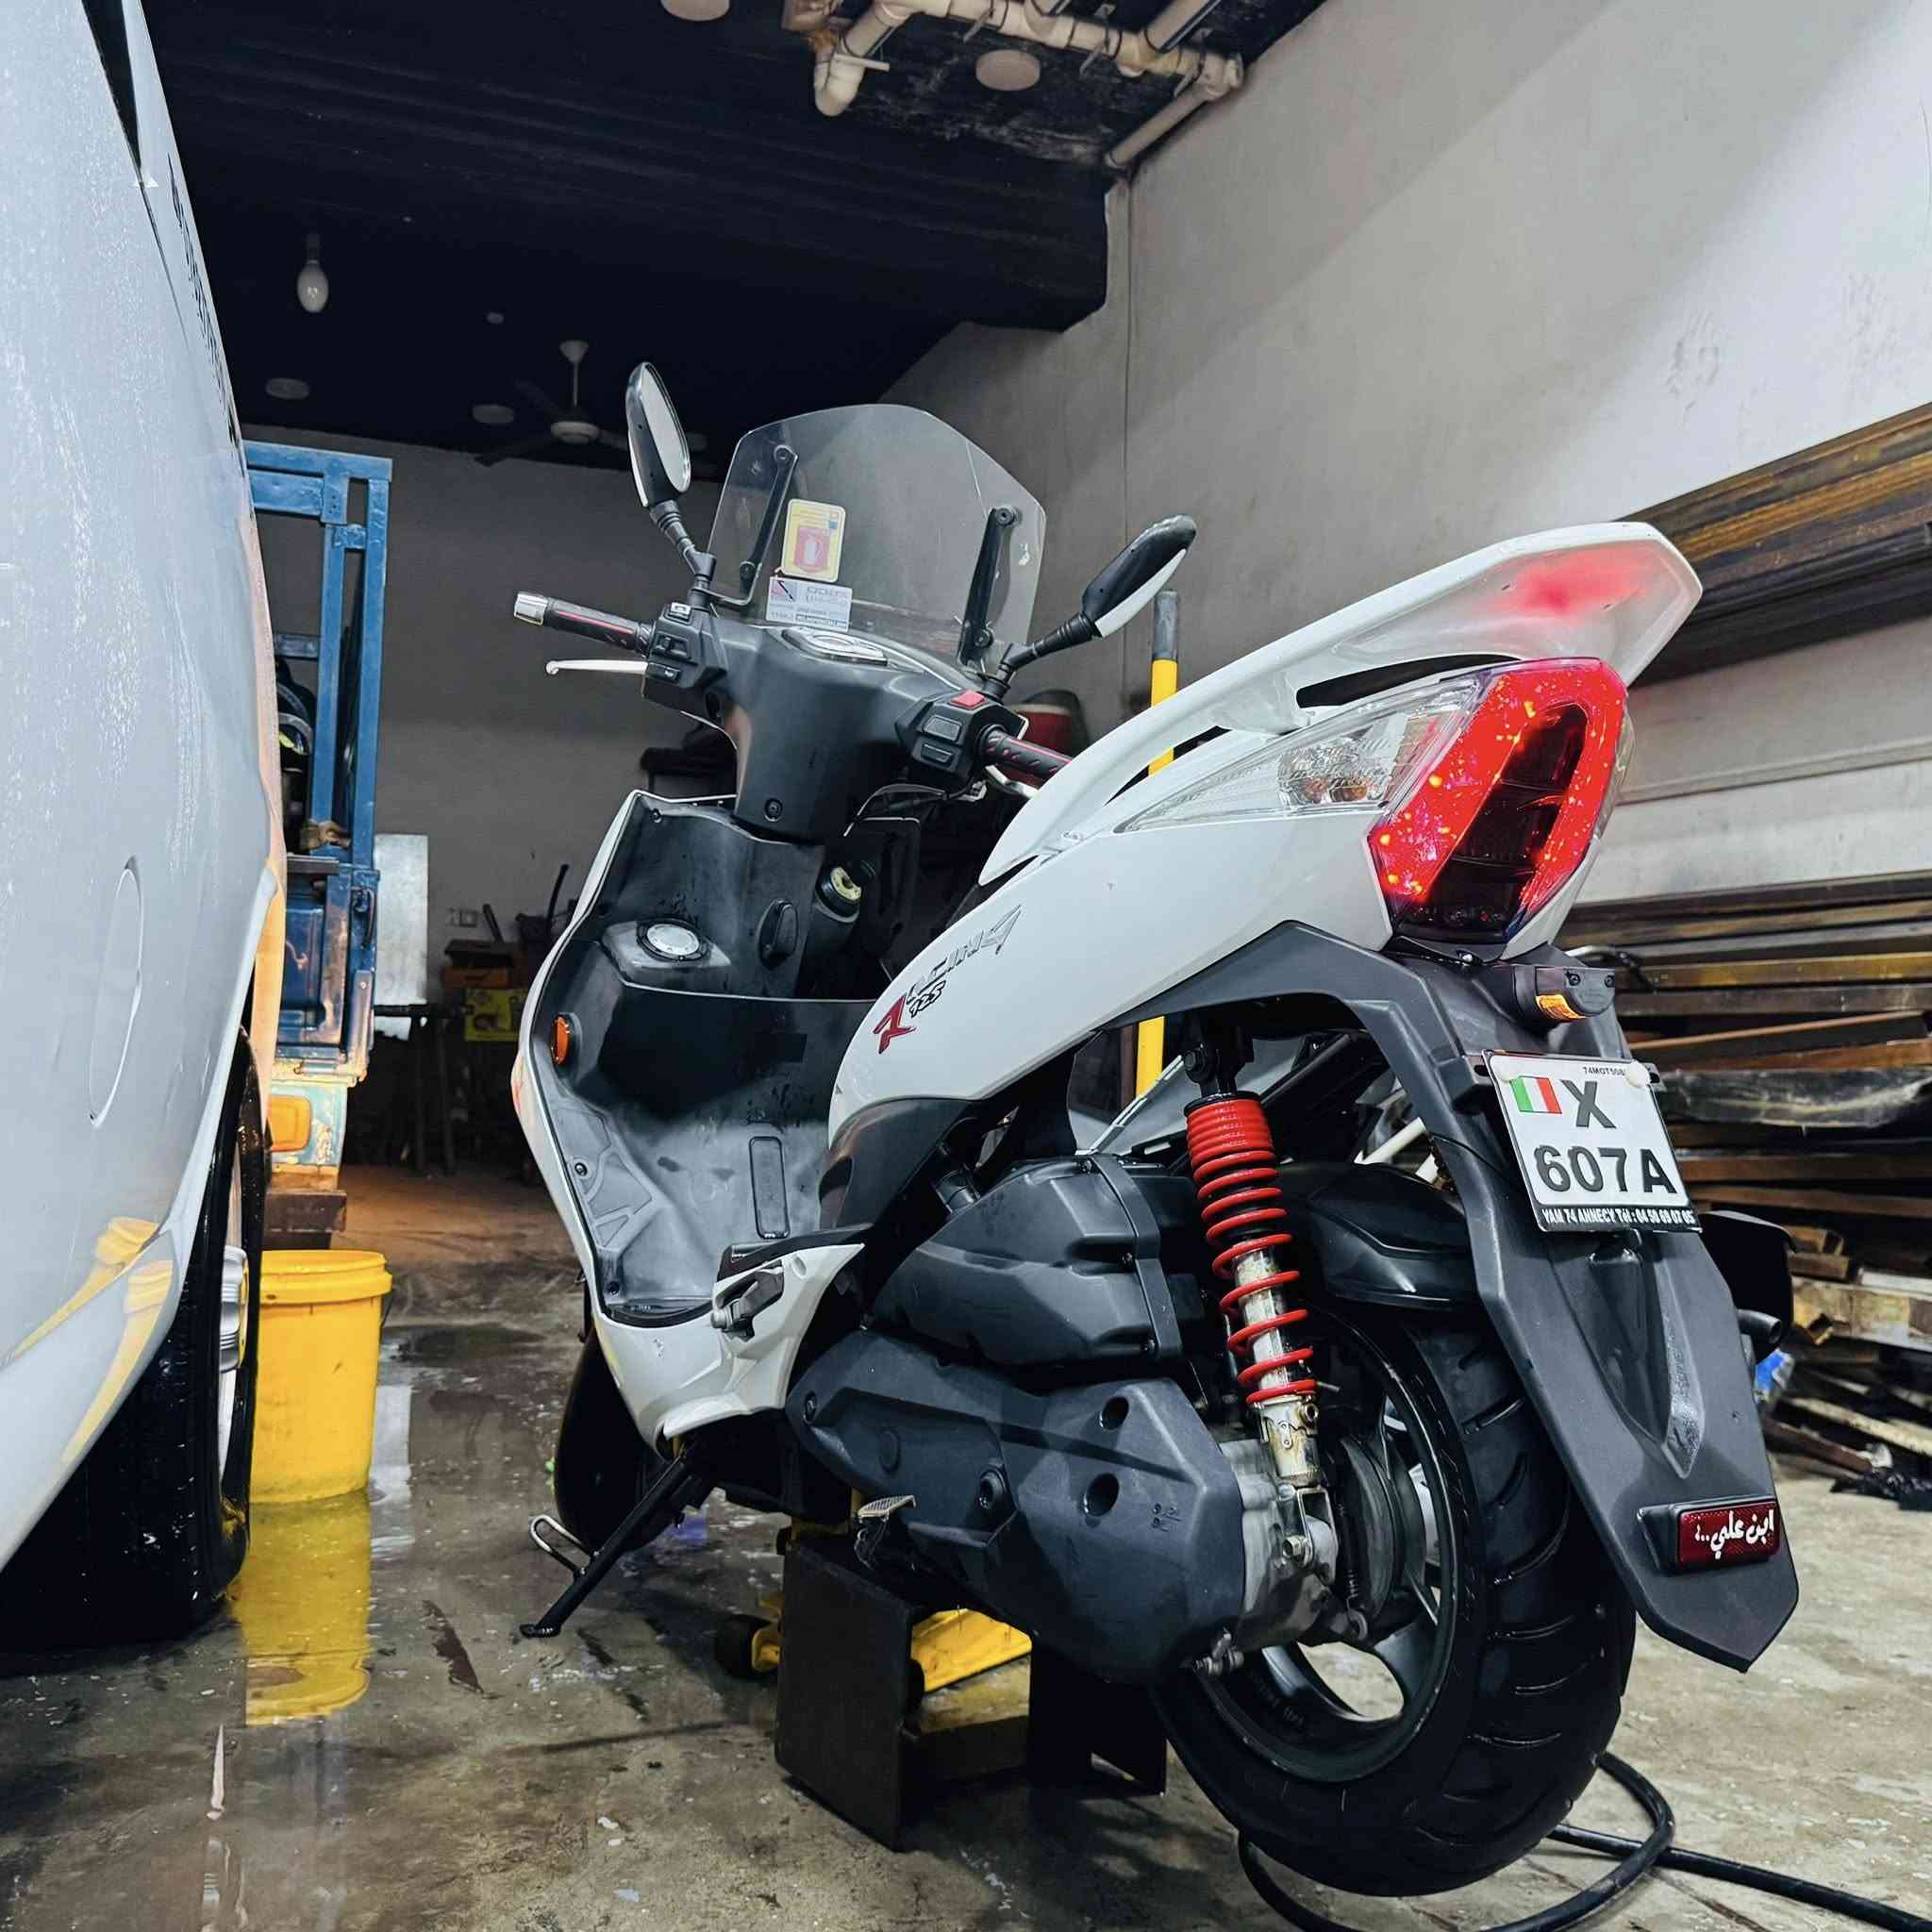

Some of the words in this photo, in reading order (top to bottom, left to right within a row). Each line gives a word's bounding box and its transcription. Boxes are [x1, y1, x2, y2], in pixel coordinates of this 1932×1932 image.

[1559, 1079, 1616, 1129] X
[1533, 1144, 1678, 1194] 607A
[1541, 1208, 1564, 1224] YAM
[1563, 1208, 1578, 1223] 74
[1577, 1208, 1616, 1223] ANNECY
[1746, 1509, 1774, 1545] ابن
